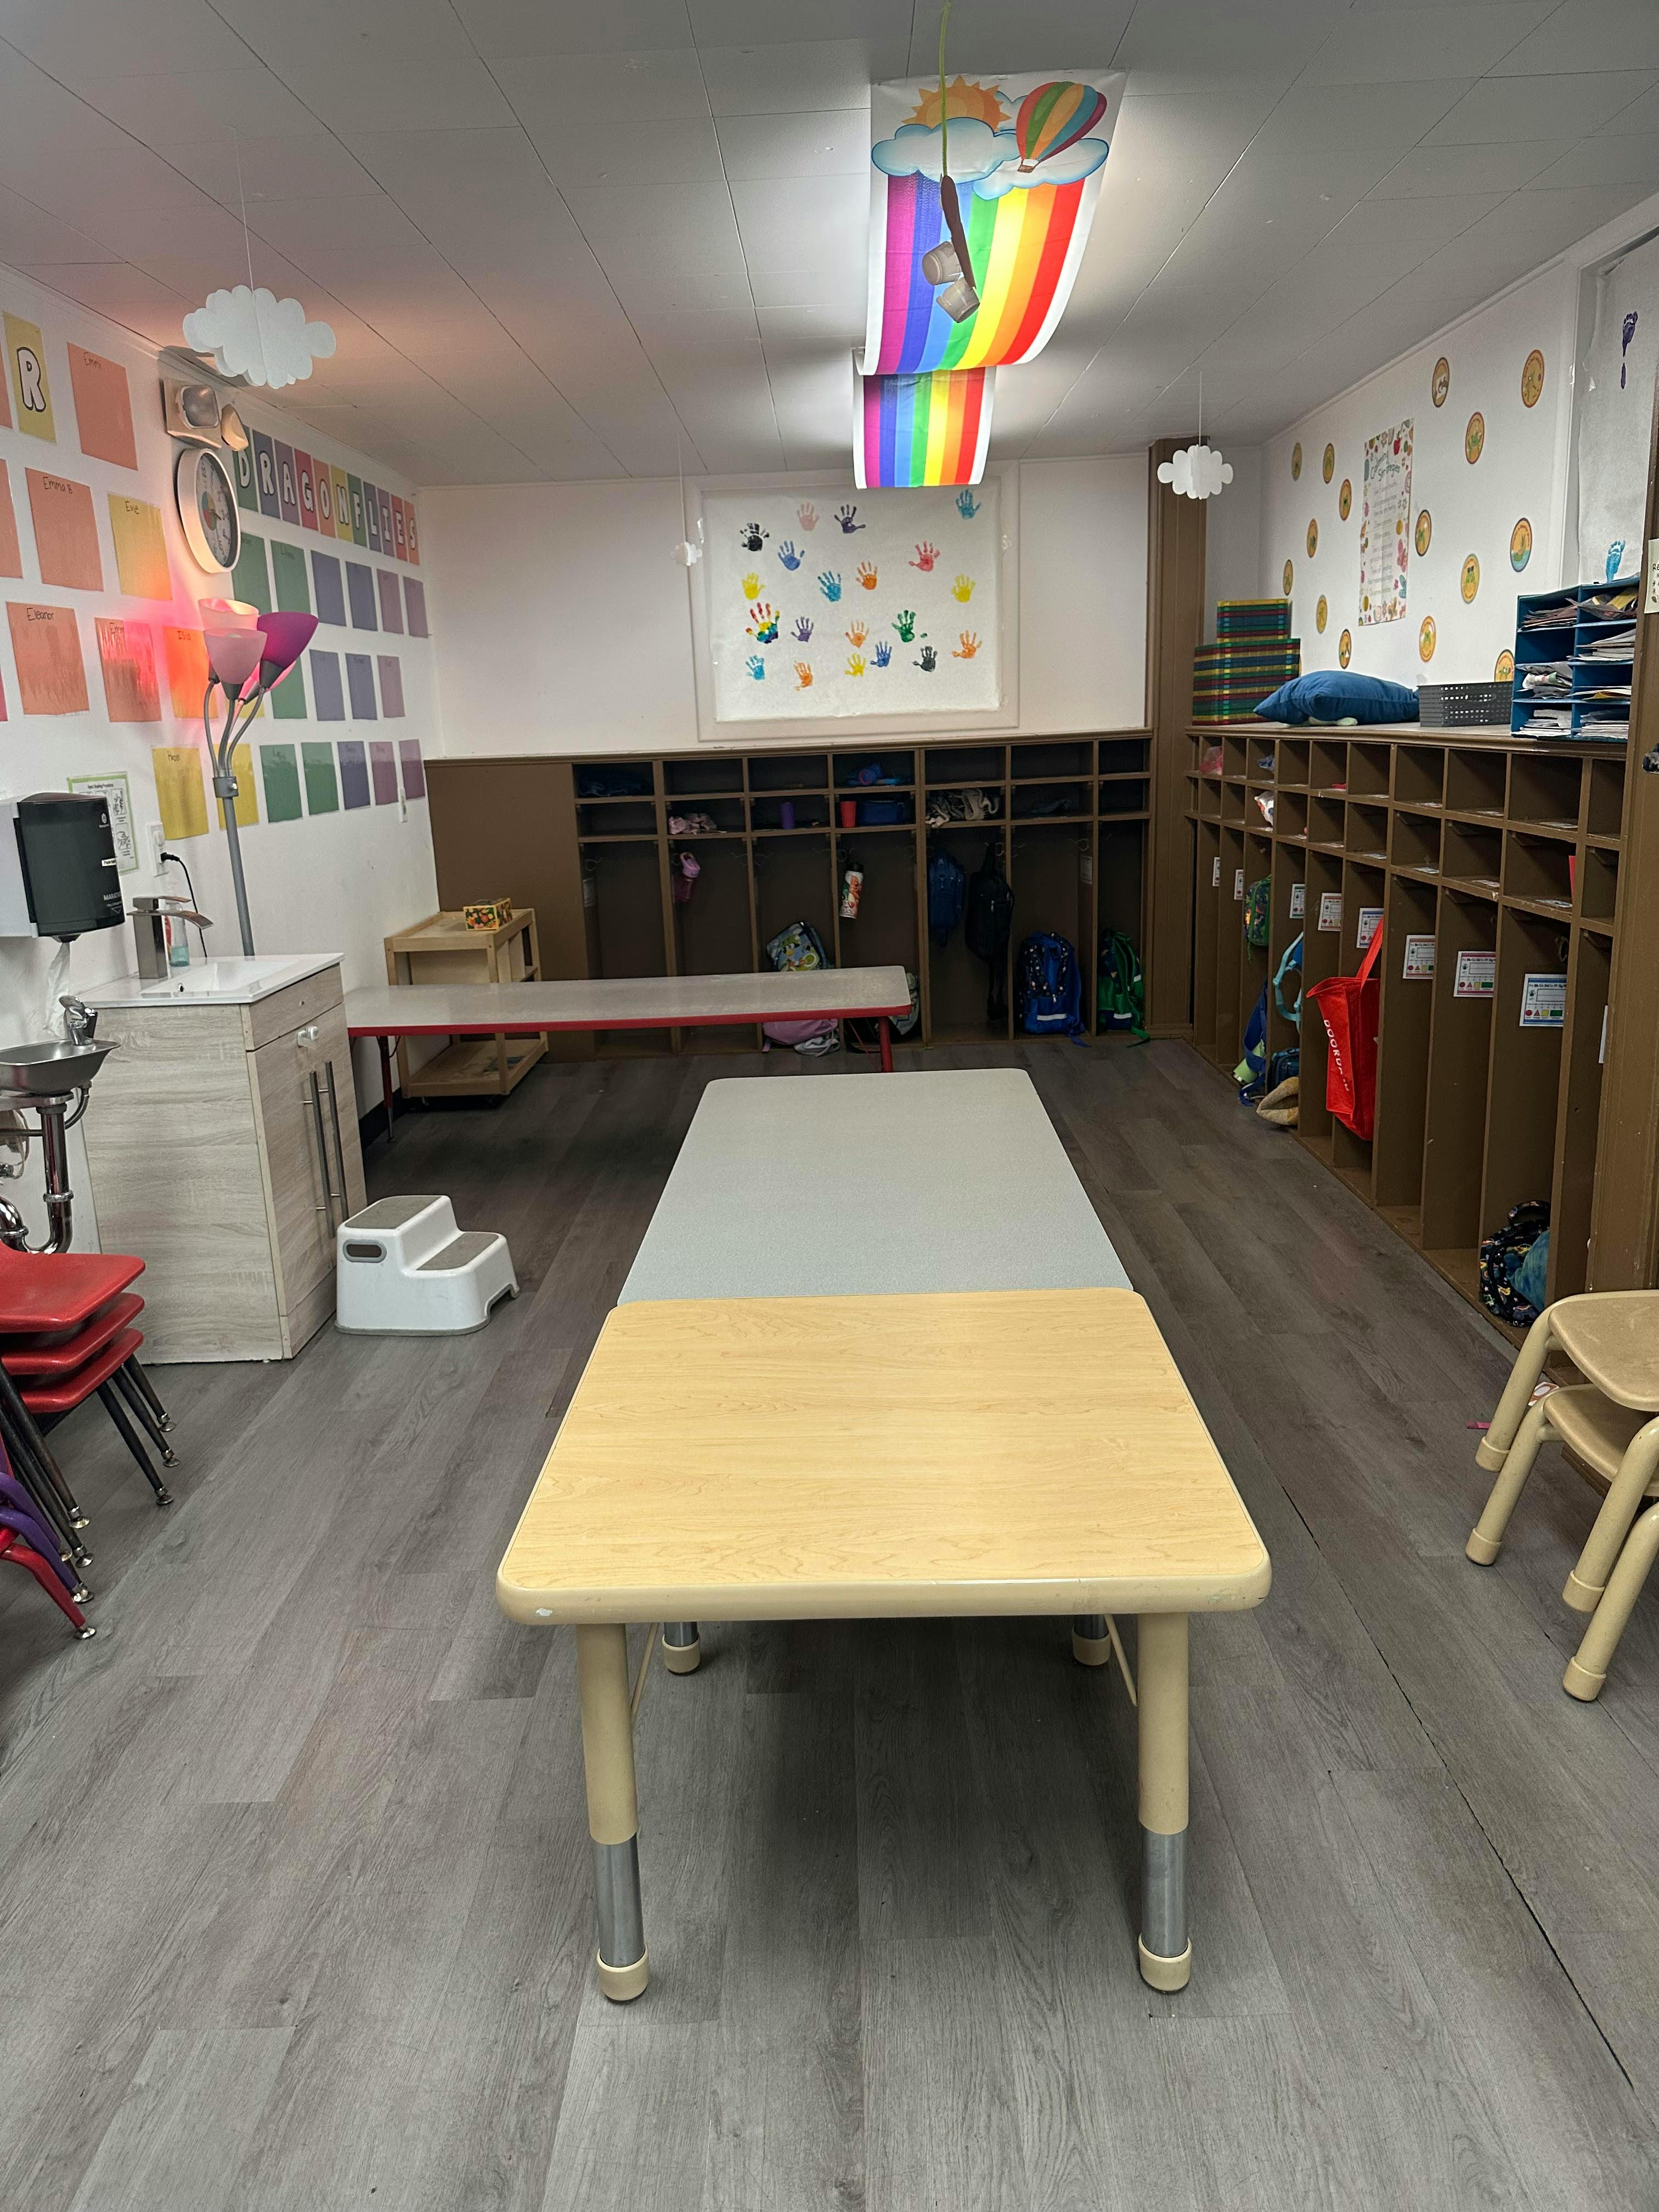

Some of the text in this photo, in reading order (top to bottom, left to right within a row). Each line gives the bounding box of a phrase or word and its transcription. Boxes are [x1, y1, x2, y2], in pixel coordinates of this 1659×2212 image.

[16, 346, 47, 413] R
[42, 476, 73, 494] Emma B
[236, 449, 416, 550] DRAGONFLIES
[26, 607, 54, 622] Eleanor
